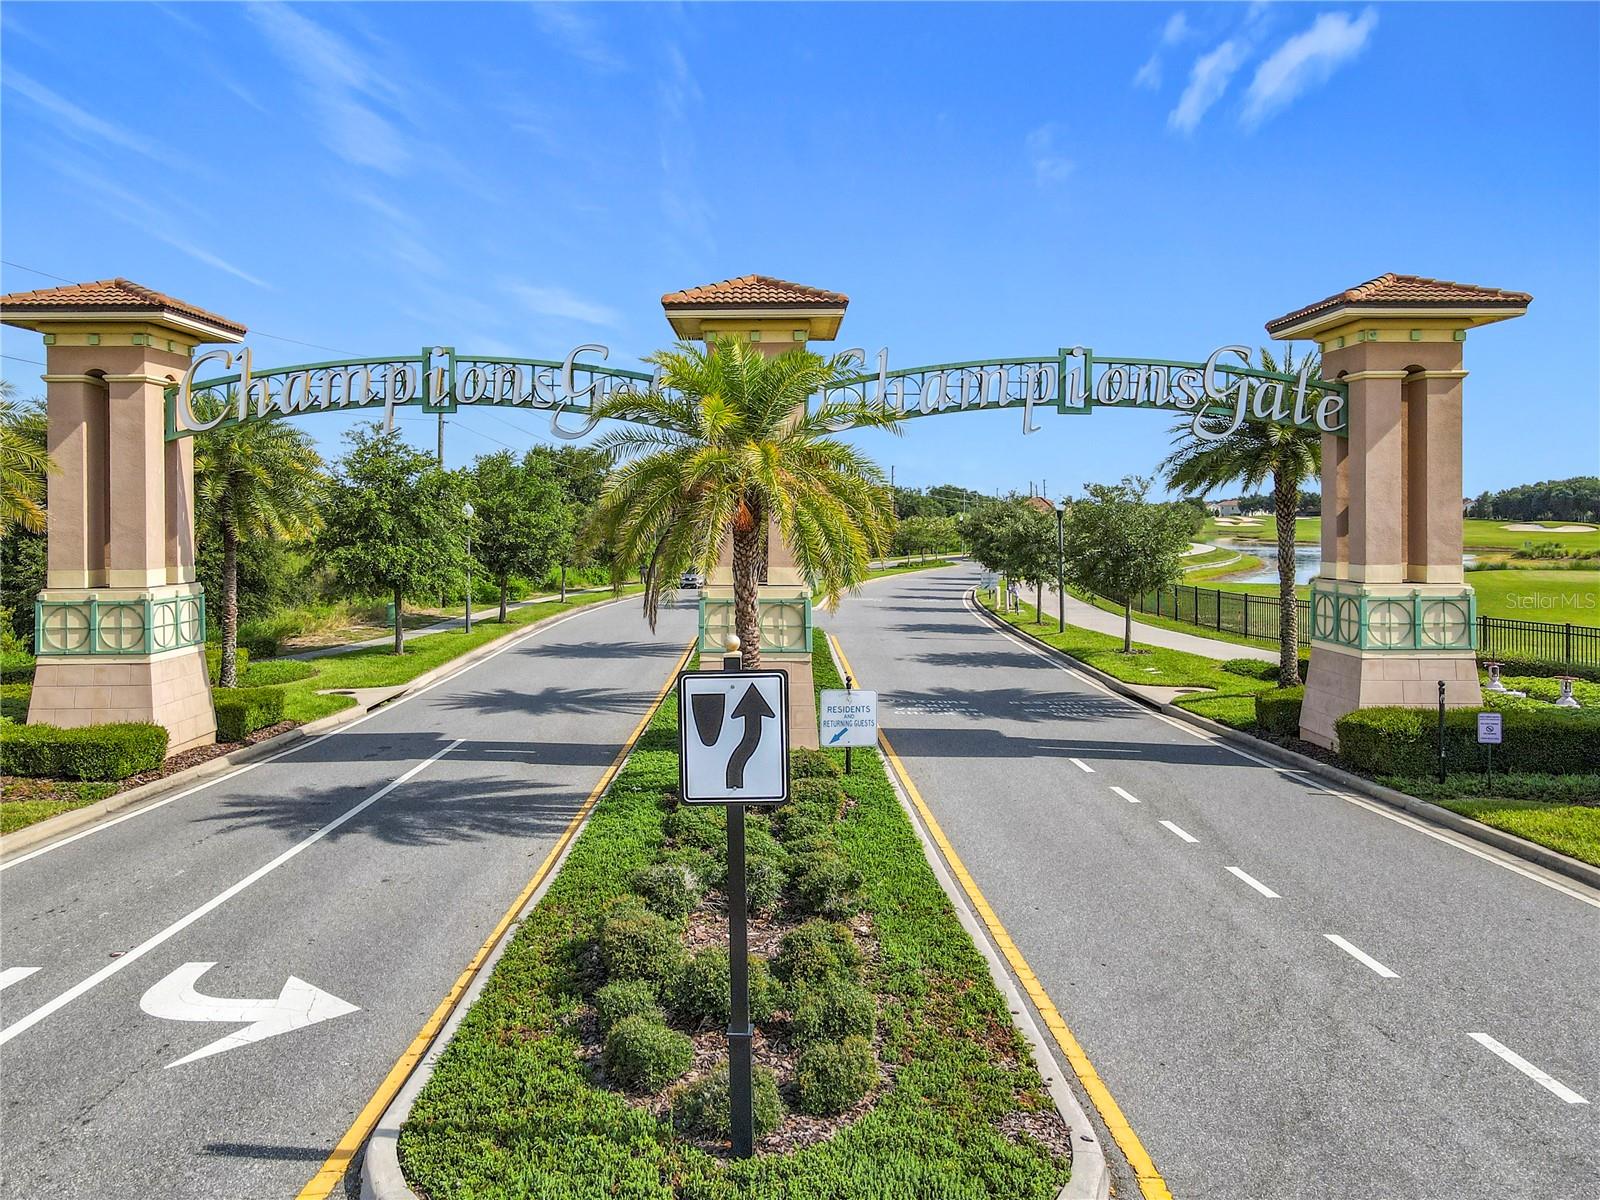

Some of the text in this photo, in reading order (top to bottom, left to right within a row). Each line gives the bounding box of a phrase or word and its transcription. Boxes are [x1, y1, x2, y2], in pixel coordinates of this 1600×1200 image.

[827, 705, 871, 714] RESIDENTS
[823, 719, 875, 728] RETURNING GUESTS
